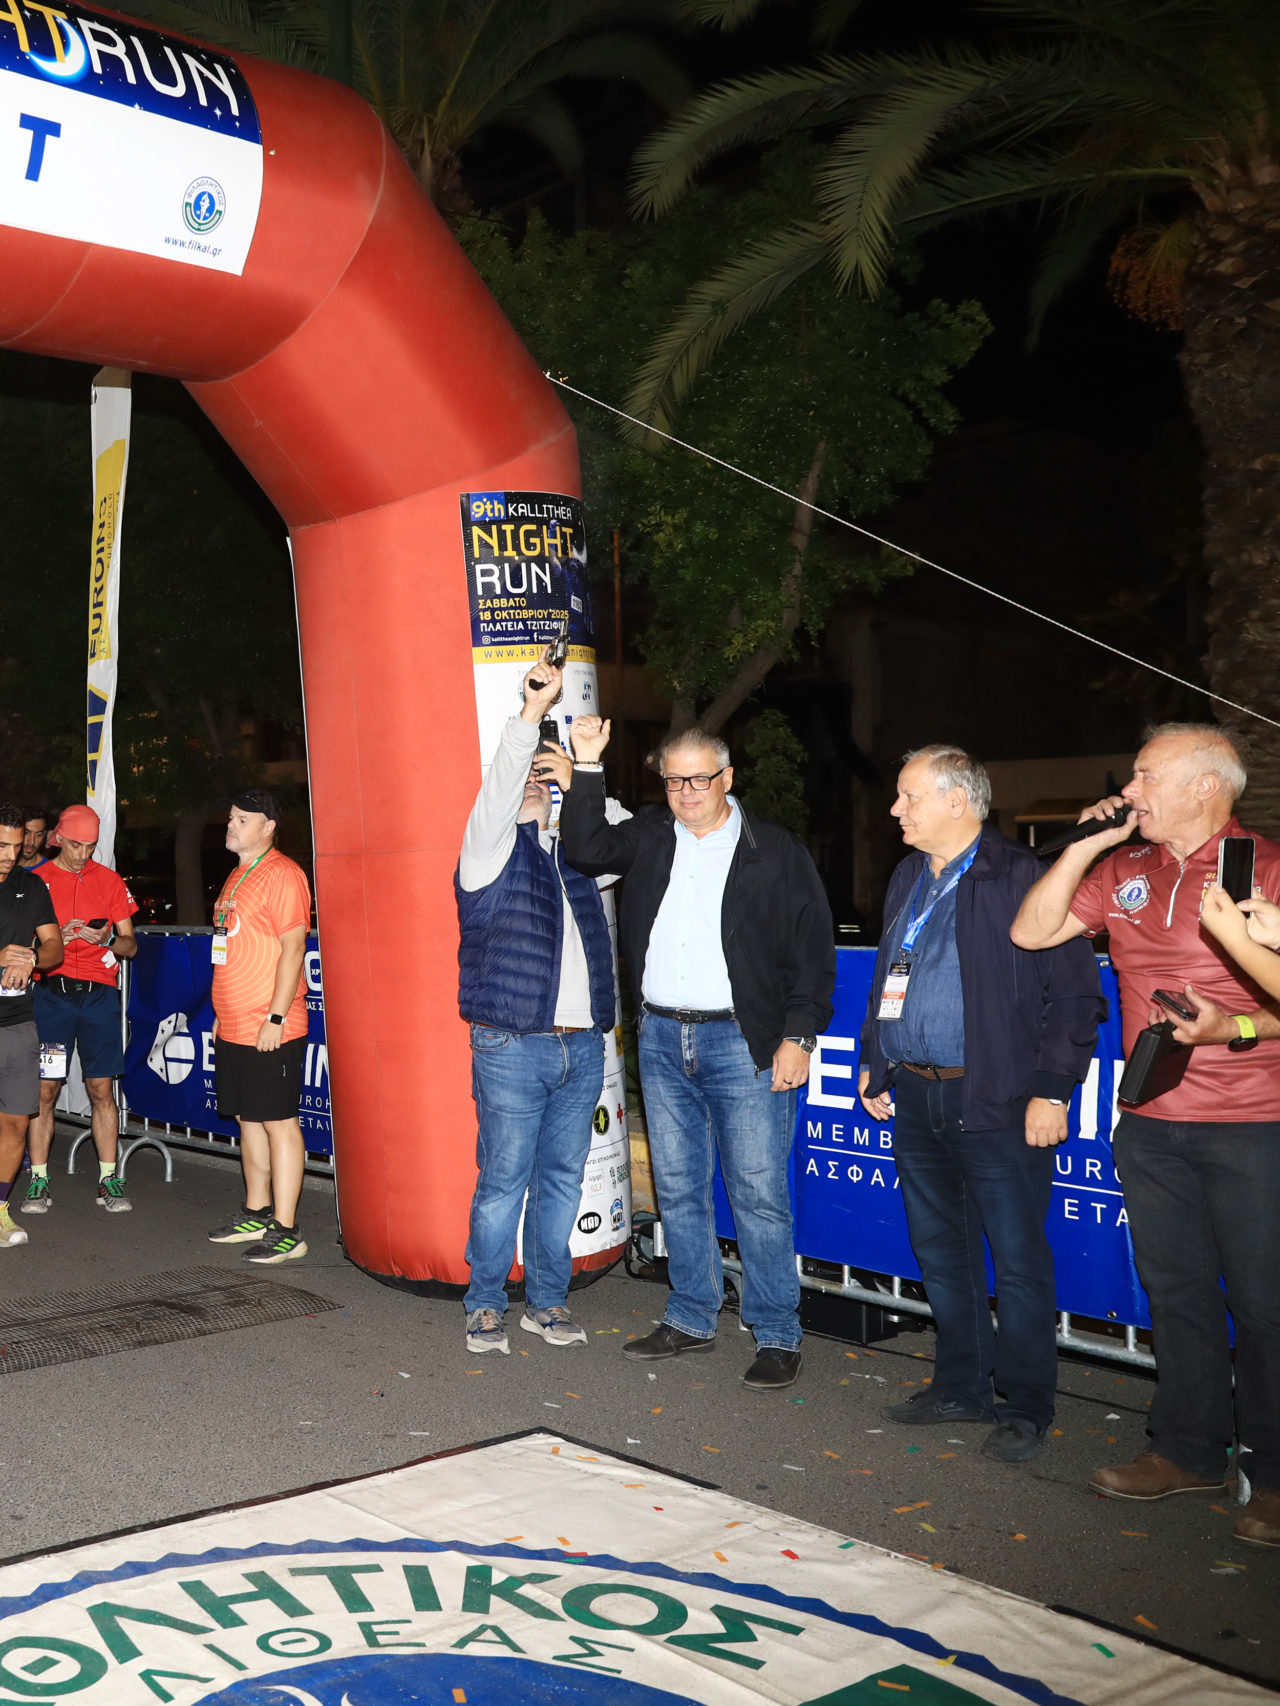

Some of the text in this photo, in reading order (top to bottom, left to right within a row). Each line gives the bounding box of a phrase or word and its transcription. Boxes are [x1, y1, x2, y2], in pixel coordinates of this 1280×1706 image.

[76, 17, 240, 118] RUN
[164, 236, 223, 258] www.filkal.gr
[472, 501, 573, 521] 9th KALLITHEA
[471, 523, 574, 559] NIGHT
[475, 563, 552, 596] RUN
[478, 597, 527, 609] ΣΑΒΒΑΤΟ
[479, 611, 492, 620] 18
[494, 609, 548, 620] ΟΚΤΩΒΡΙΟΥ
[480, 620, 562, 632] ΠΛΑΤΕΙΑ ΤΖΙΤΖΙΦΙ
[581, 1215, 600, 1231] MAD
[138, 1619, 636, 1704] ΛΙΘΕΑΣ
